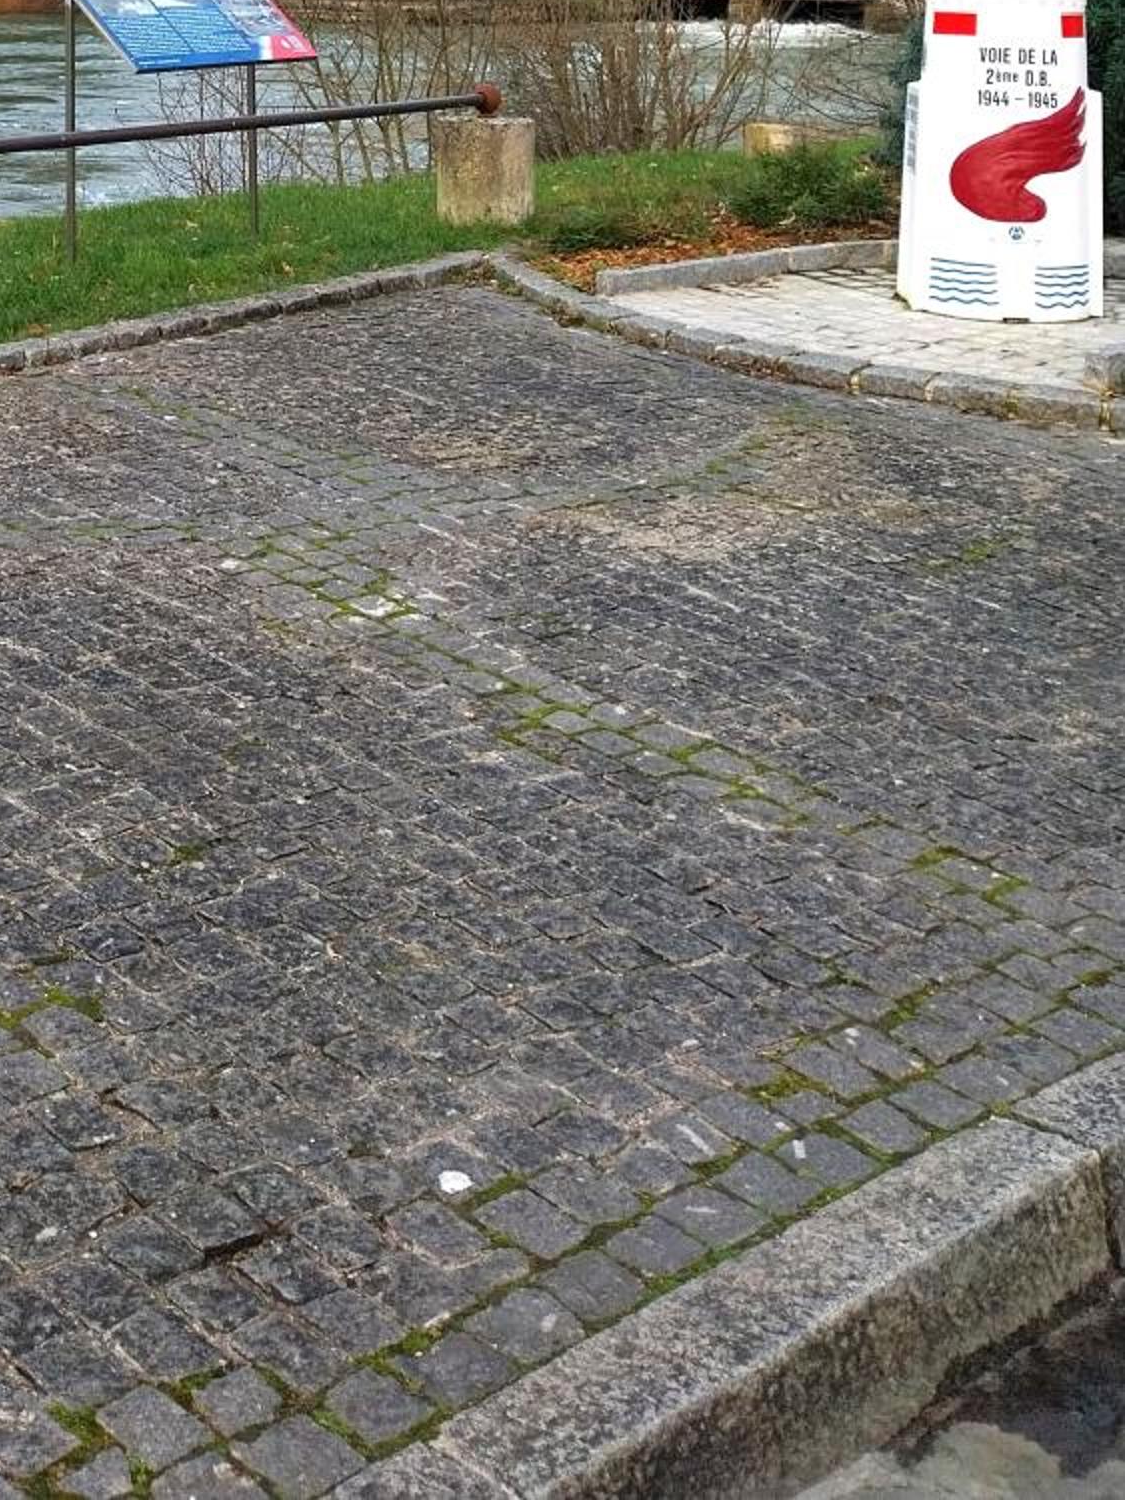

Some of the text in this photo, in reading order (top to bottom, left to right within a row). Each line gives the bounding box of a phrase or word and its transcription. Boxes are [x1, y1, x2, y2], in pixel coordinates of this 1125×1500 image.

[979, 47, 1058, 66] VOIE DE LA
[986, 67, 1051, 87] 2ème D.B.
[978, 89, 1009, 107] 1944
[1028, 91, 1058, 109] 1945
